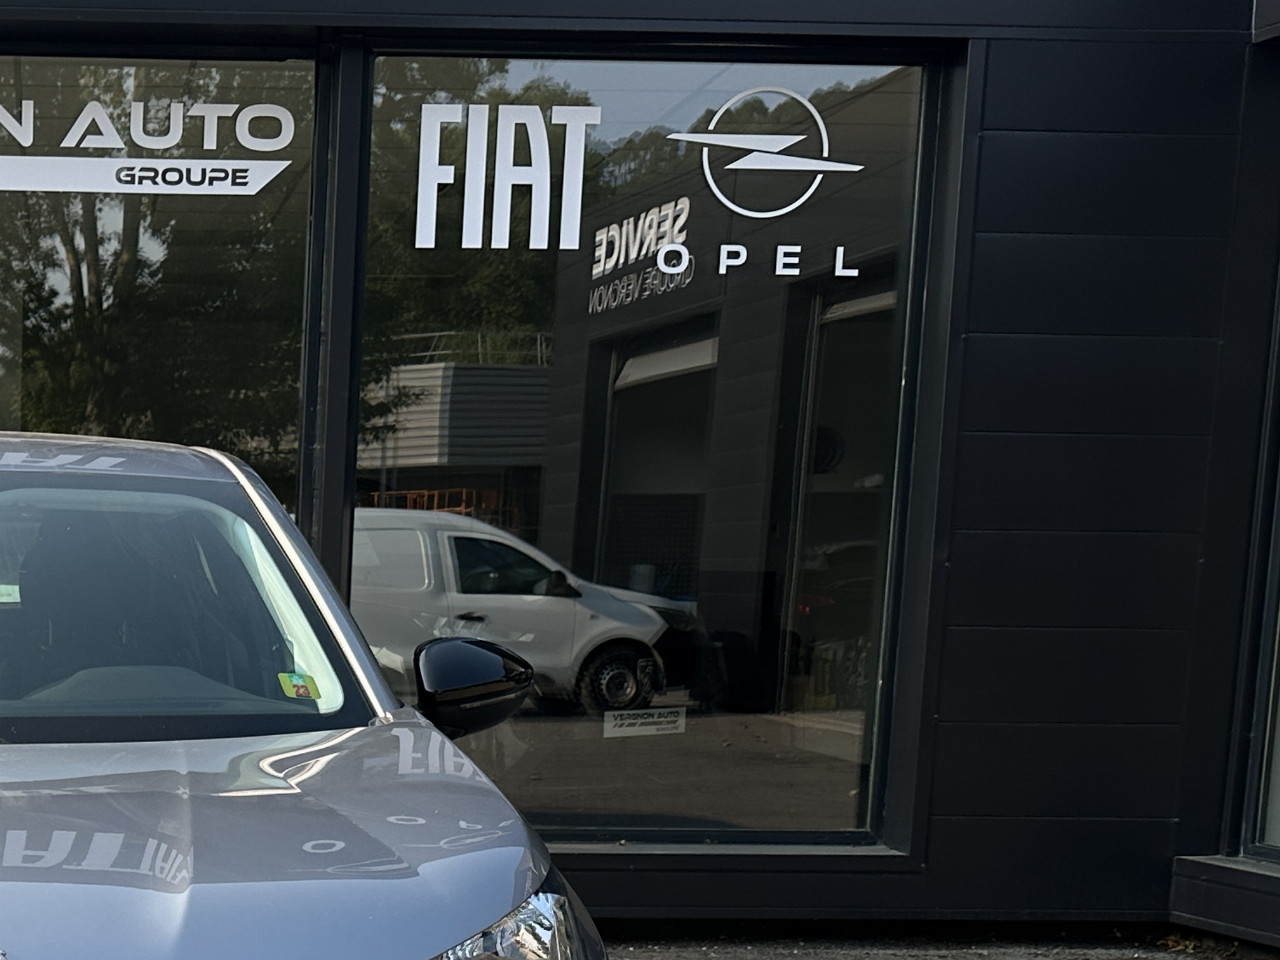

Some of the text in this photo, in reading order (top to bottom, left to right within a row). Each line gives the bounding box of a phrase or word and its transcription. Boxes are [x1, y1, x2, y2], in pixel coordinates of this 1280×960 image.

[60, 99, 296, 152] AUTO
[114, 164, 251, 188] GROUPE
[414, 103, 603, 251] FIAT
[655, 242, 860, 278] OPEL
